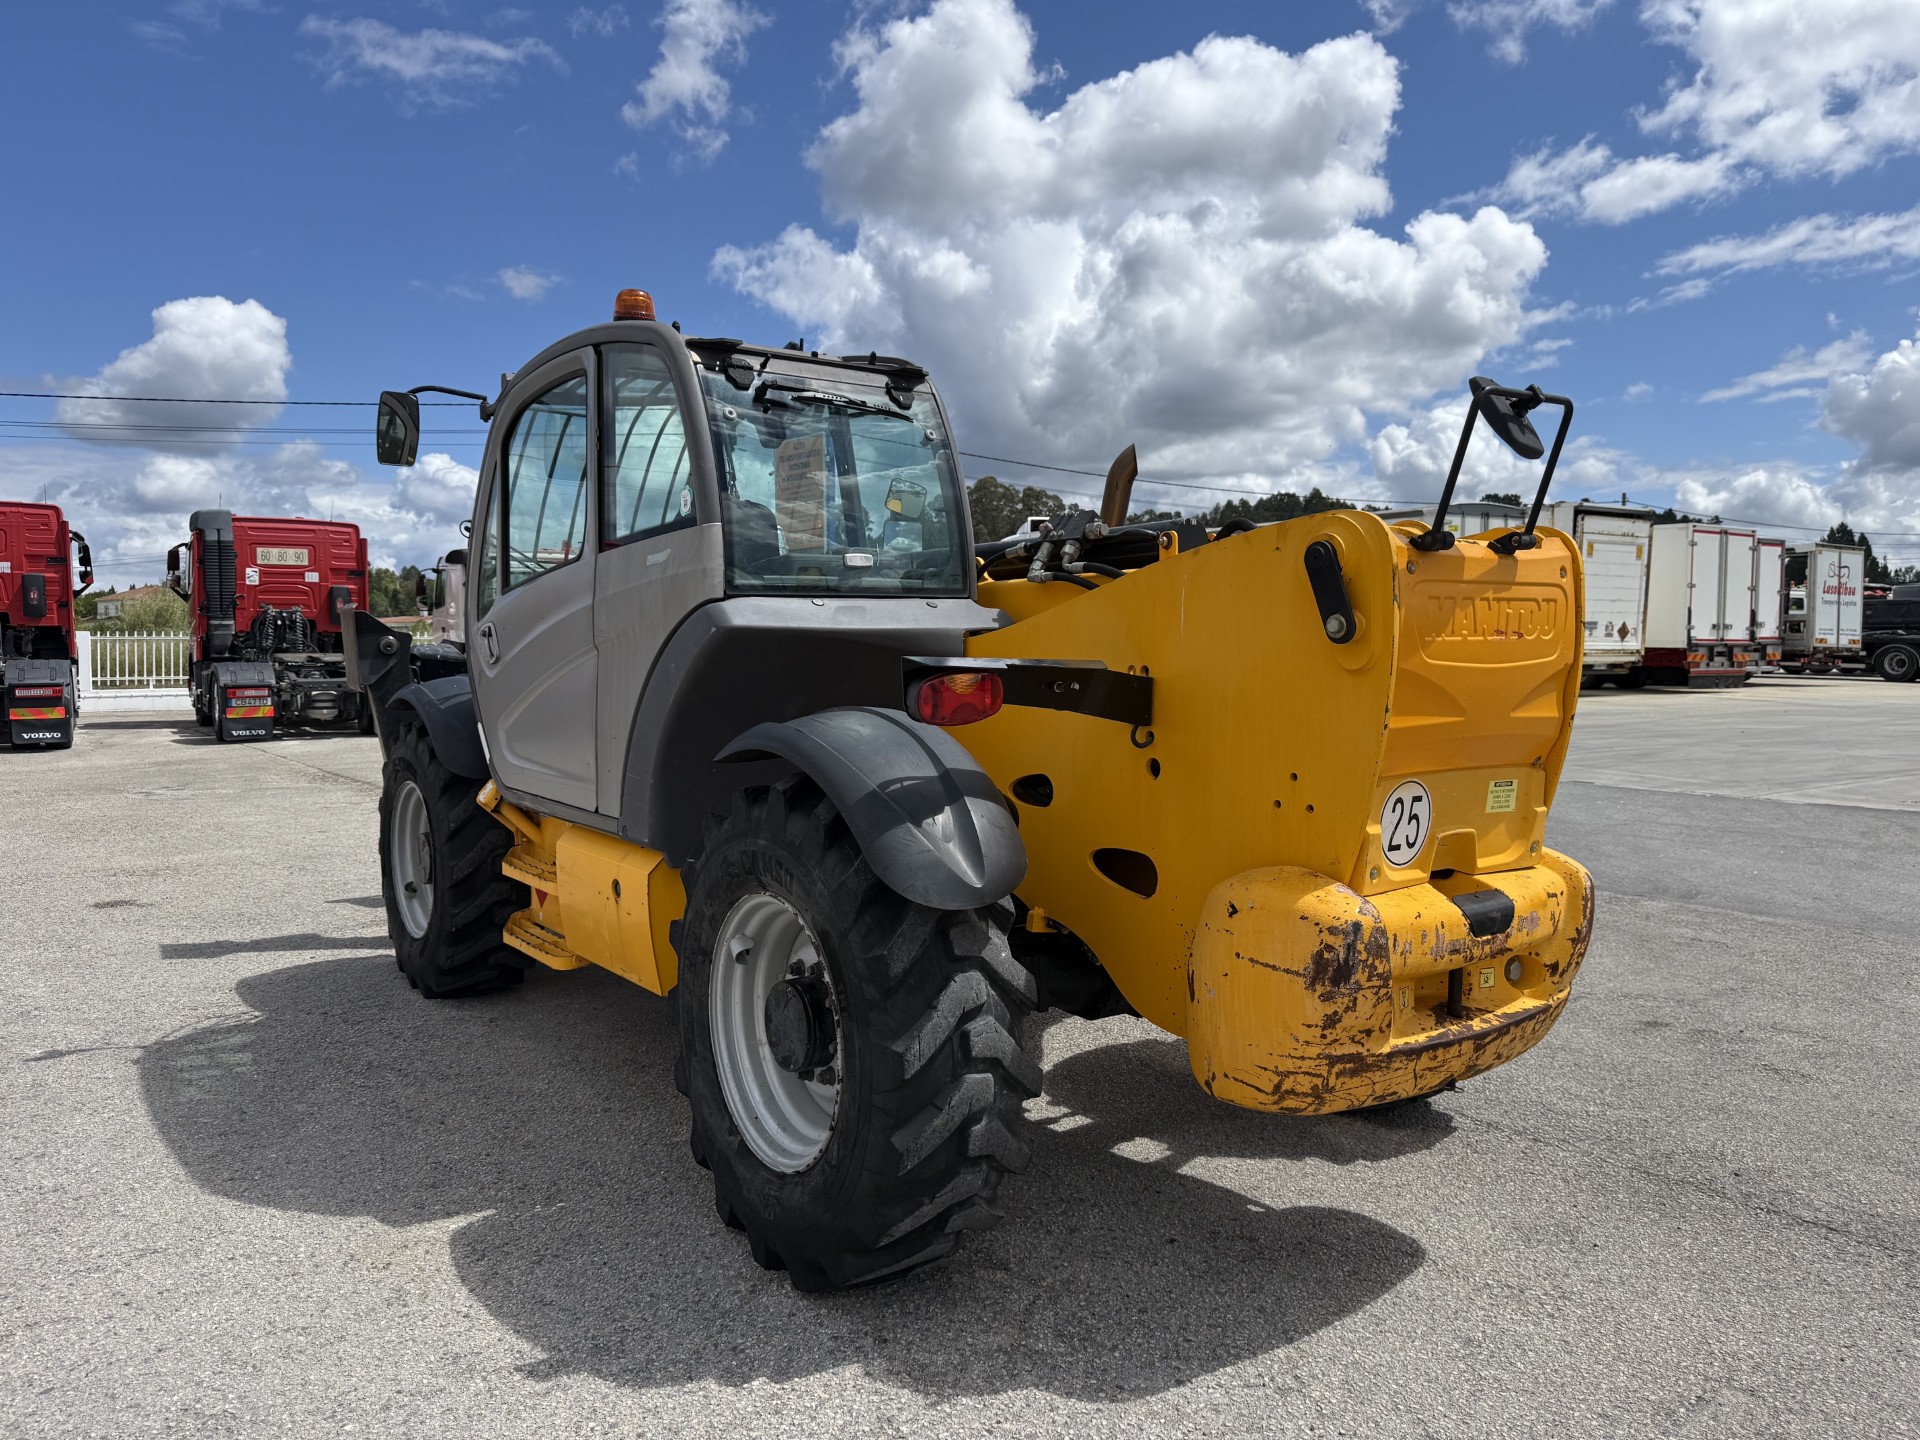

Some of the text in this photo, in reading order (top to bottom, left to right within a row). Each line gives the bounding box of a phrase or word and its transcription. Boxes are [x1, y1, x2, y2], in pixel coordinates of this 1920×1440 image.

[260, 550, 271, 562] 60
[277, 551, 288, 562] 80
[294, 551, 304, 562] 90
[1425, 596, 1558, 640] MANITOU
[1387, 795, 1423, 852] 25
